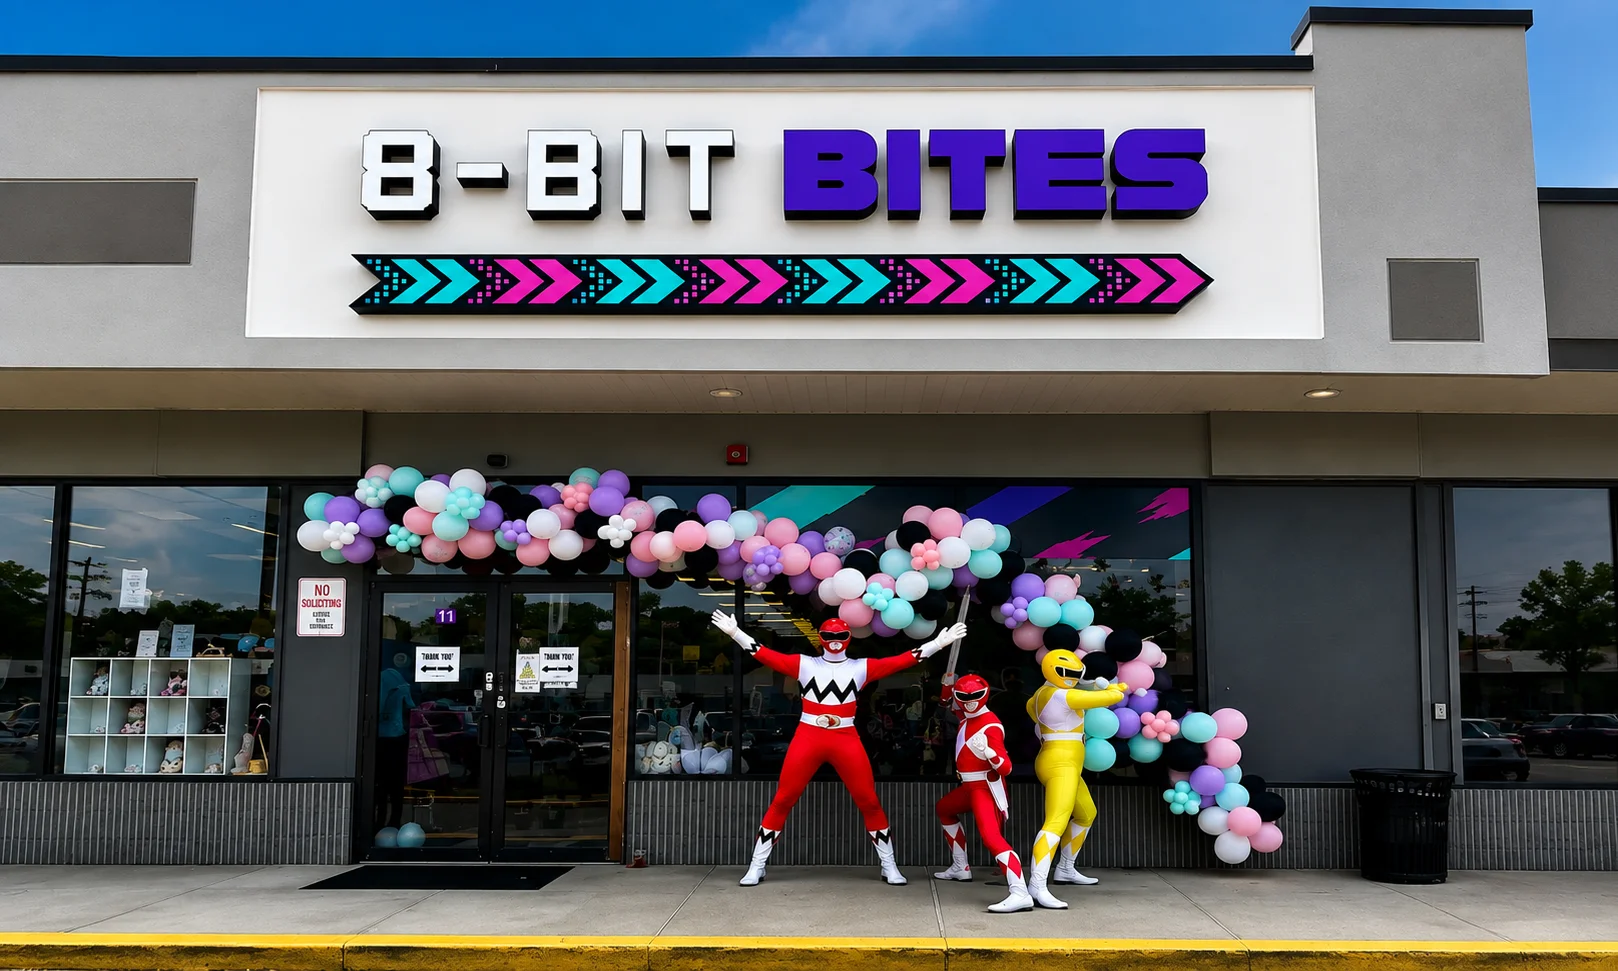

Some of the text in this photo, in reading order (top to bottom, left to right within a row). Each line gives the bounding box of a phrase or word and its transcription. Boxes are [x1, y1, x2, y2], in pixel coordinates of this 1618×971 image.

[360, 129, 1209, 220] 8-BIT BITES
[314, 584, 330, 597] NO
[438, 609, 454, 623] 11
